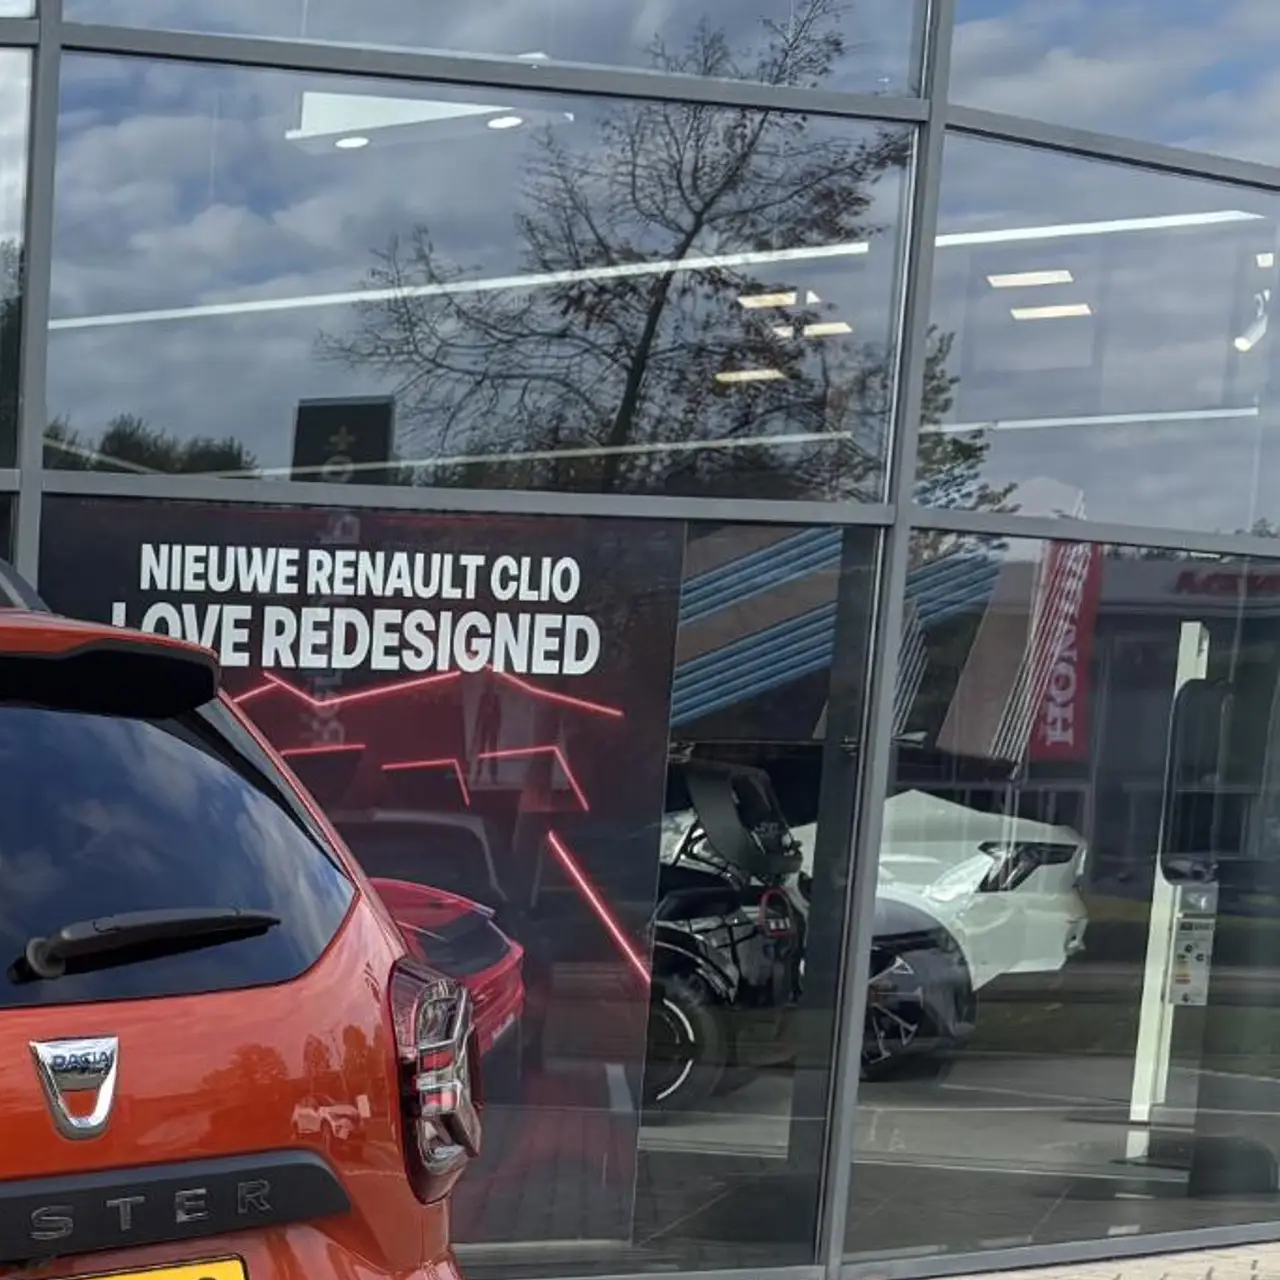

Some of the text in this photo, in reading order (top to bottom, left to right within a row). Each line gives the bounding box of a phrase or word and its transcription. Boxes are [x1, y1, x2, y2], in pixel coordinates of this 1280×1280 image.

[140, 543, 581, 603] NIEUWE RENAULT CLIO
[261, 605, 601, 676] REDESIGNED
[52, 1050, 111, 1068] DACIA
